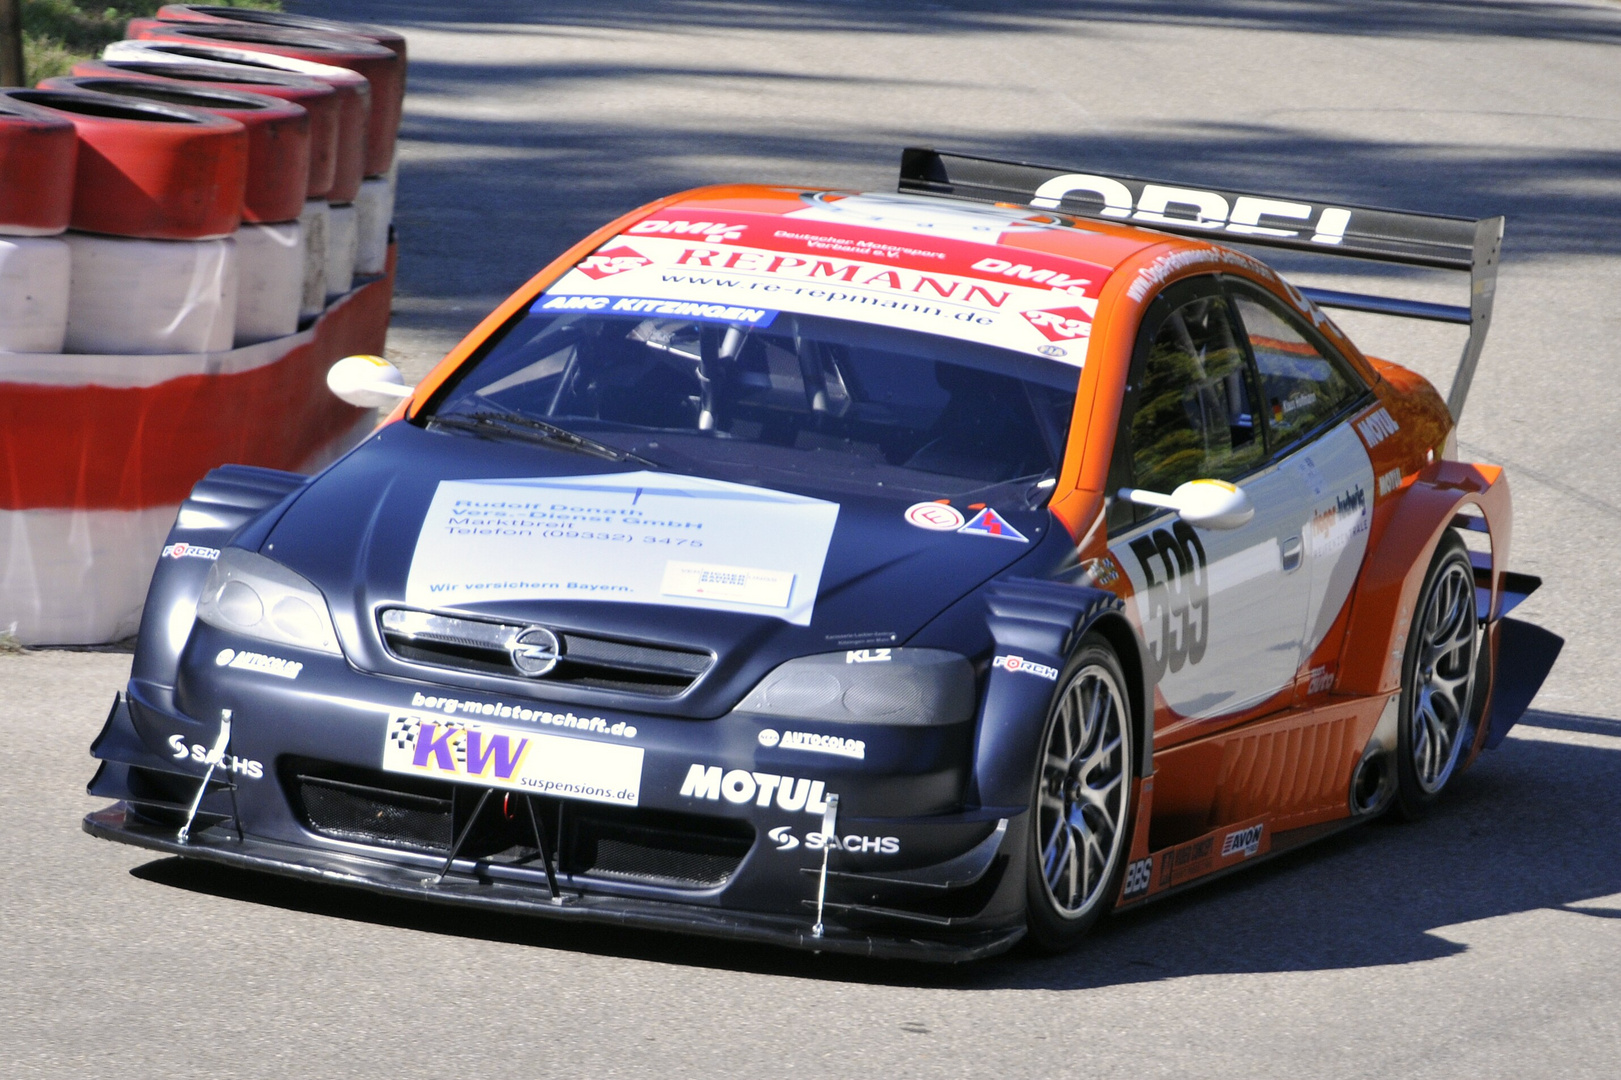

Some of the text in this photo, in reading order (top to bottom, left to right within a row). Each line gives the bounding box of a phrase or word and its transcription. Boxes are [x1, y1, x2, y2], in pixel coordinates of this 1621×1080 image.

[773, 230, 946, 260] Deutscher Motorsport
[806, 239, 871, 254] Verband
[675, 248, 1013, 308] REPMANN
[542, 296, 766, 323] AMC KITZINGEN
[661, 274, 994, 326] www.re-repmann.de
[1356, 406, 1400, 449] MOTUL
[454, 500, 645, 517] Rudolf Donath
[448, 517, 575, 530] Marktbreit
[622, 515, 703, 530] GmbH
[446, 526, 704, 548] Telefon (09332) 3475
[429, 580, 635, 594] Wir versichern Bayern.
[845, 648, 892, 664] KLZ
[411, 691, 638, 739] berg-meisterschaft.de
[411, 721, 533, 783] KW
[779, 730, 866, 757] AUTOCOLOR
[519, 775, 636, 803] suspensions.de
[678, 762, 828, 815] MOTUL
[1230, 825, 1263, 851] AVON
[1123, 857, 1153, 895] BBS
